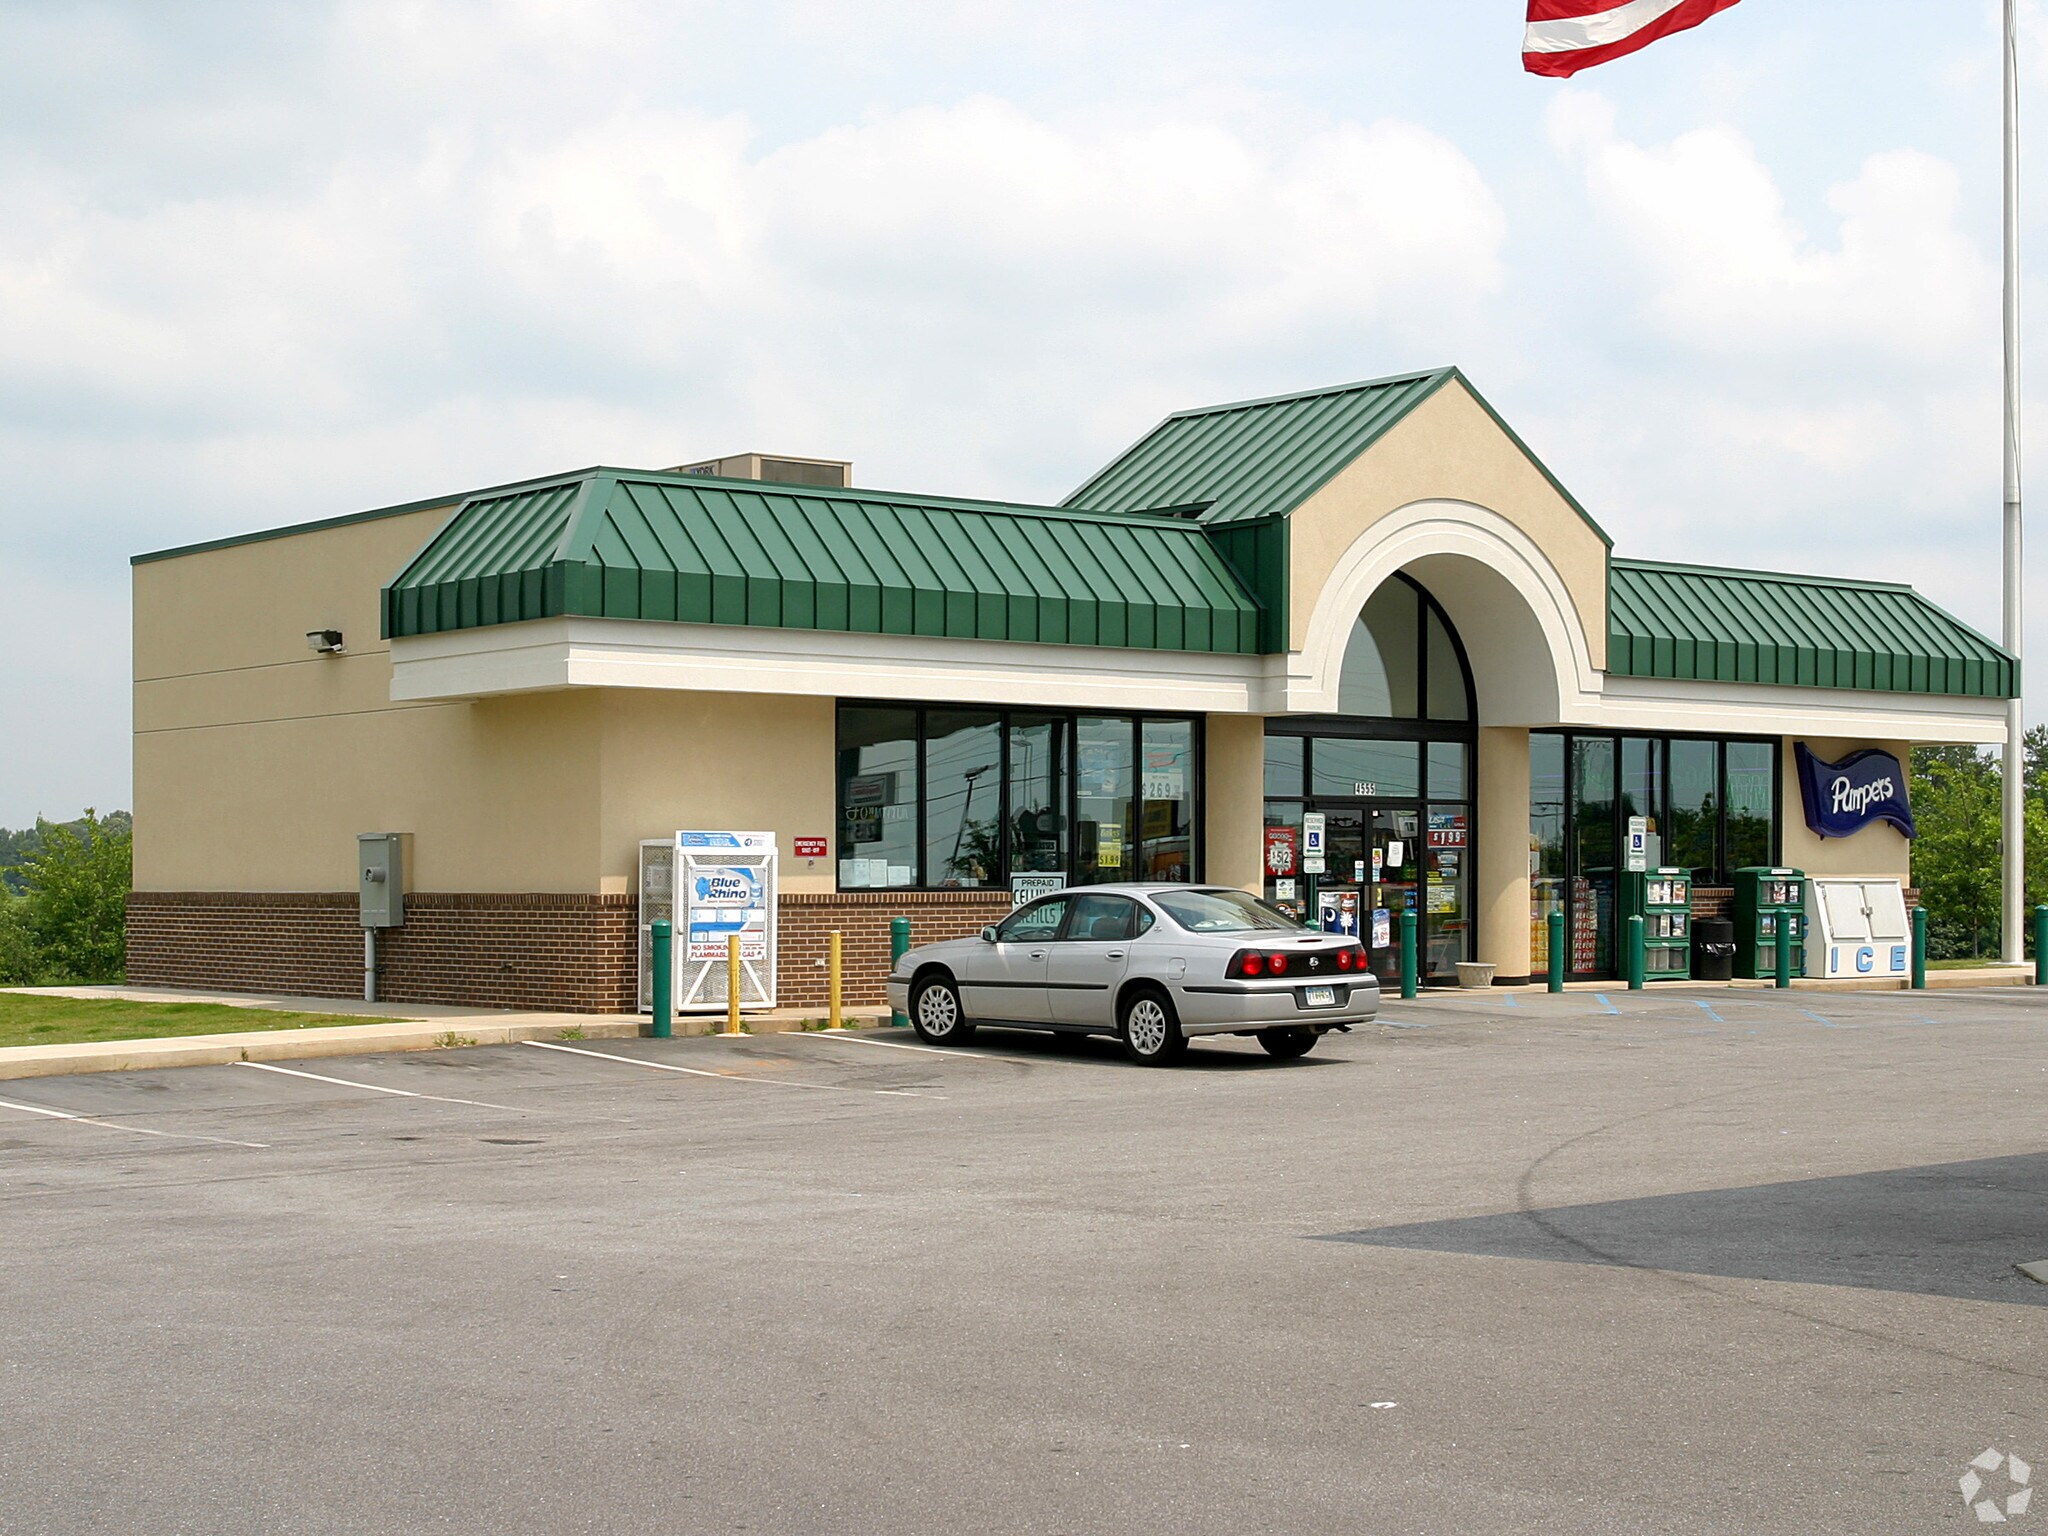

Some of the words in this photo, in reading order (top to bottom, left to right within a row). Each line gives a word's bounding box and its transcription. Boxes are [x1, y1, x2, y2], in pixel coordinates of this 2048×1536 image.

[1356, 783, 1375, 794] 4555
[1831, 776, 1894, 816] Pumpers
[711, 877, 741, 888] Blue
[1022, 879, 1055, 887] PREPAID
[709, 888, 747, 899] Rhino
[1831, 945, 1907, 973] ICE
